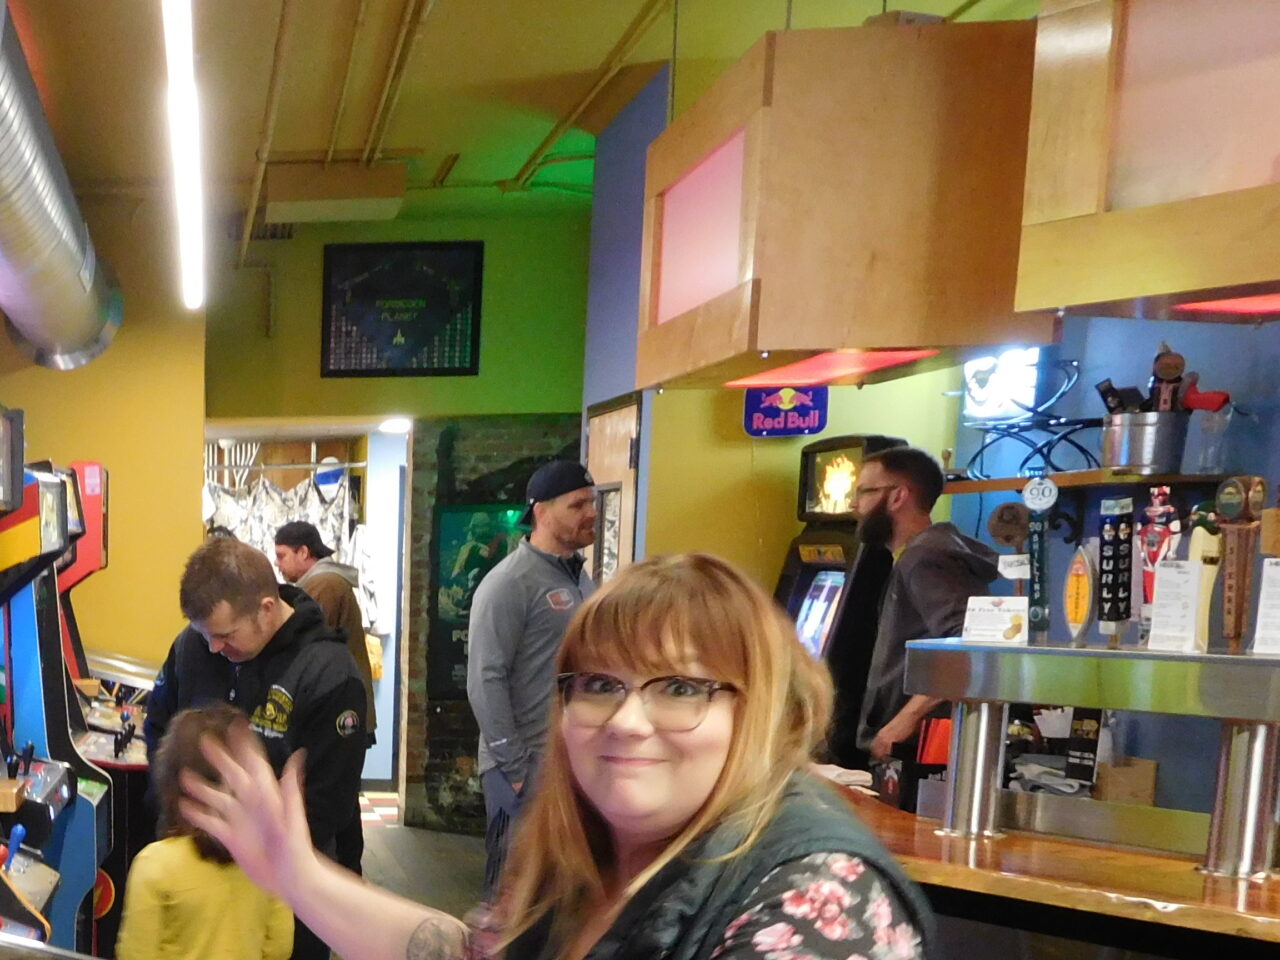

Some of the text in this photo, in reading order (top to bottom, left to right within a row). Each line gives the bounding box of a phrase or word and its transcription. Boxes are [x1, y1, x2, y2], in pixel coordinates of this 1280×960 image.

[752, 410, 819, 430] Red Bull
[1029, 486, 1052, 500] 90
[1101, 545, 1115, 614] SURLY
[1117, 543, 1130, 613] SURLY
